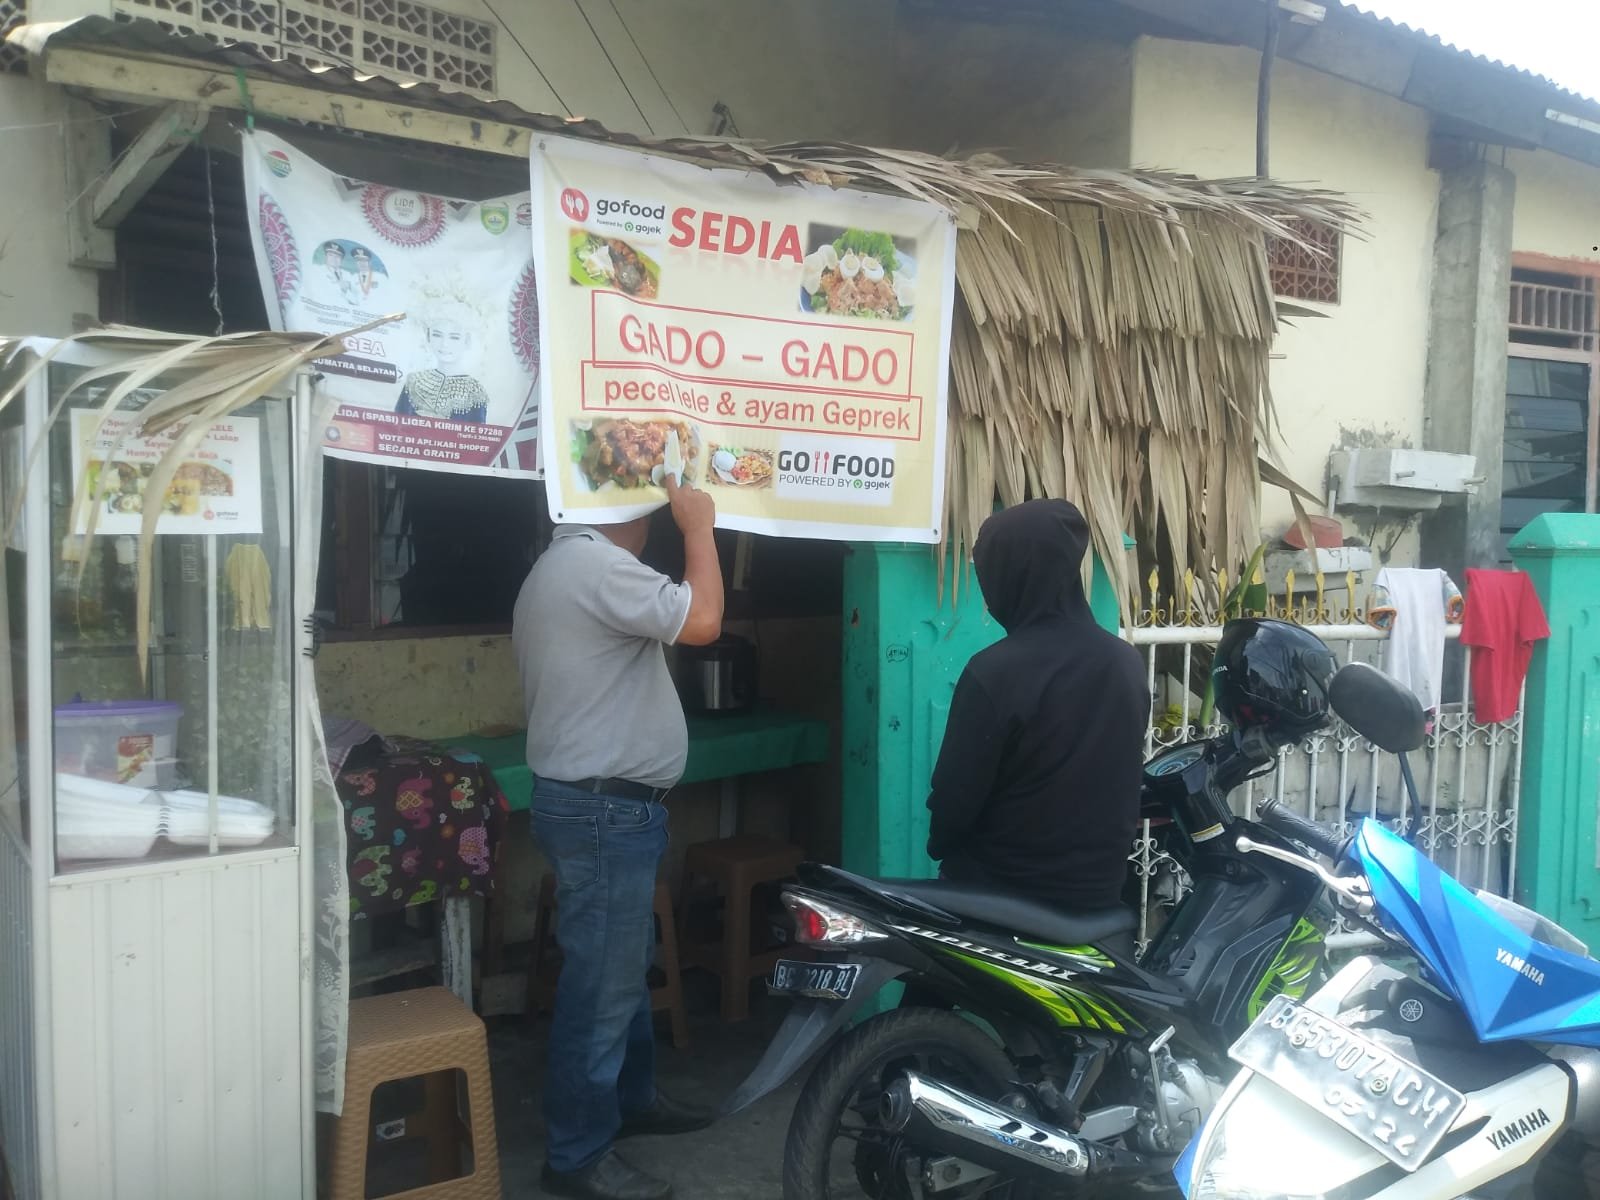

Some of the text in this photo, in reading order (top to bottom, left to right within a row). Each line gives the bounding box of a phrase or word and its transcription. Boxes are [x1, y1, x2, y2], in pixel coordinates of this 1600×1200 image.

[596, 199, 666, 220] gofood
[635, 224, 661, 235] gojek
[668, 206, 804, 264] SEDIA
[618, 314, 726, 370] GADO
[780, 339, 899, 386] GADO
[357, 364, 396, 377] SELATAN
[605, 379, 911, 431] pecel lele & ayam Geprek
[336, 408, 360, 418] LIDA
[362, 411, 399, 425] (SPASI)
[401, 416, 432, 429] LIGEA
[434, 421, 462, 432] KIRIM
[463, 424, 477, 434] KE
[378, 433, 403, 443] VOTE
[404, 435, 415, 444] DI
[417, 438, 457, 449] APLIKASI
[459, 443, 490, 453] SHOPEE
[378, 443, 461, 460] SECARA GRATIS
[777, 450, 895, 478] GO FOOD
[779, 474, 891, 490] POWERED BY gojek
[1495, 947, 1546, 987] YAMAHA
[1303, 1024, 1387, 1081] 5307
[1485, 1107, 1551, 1151] YAMAHA
